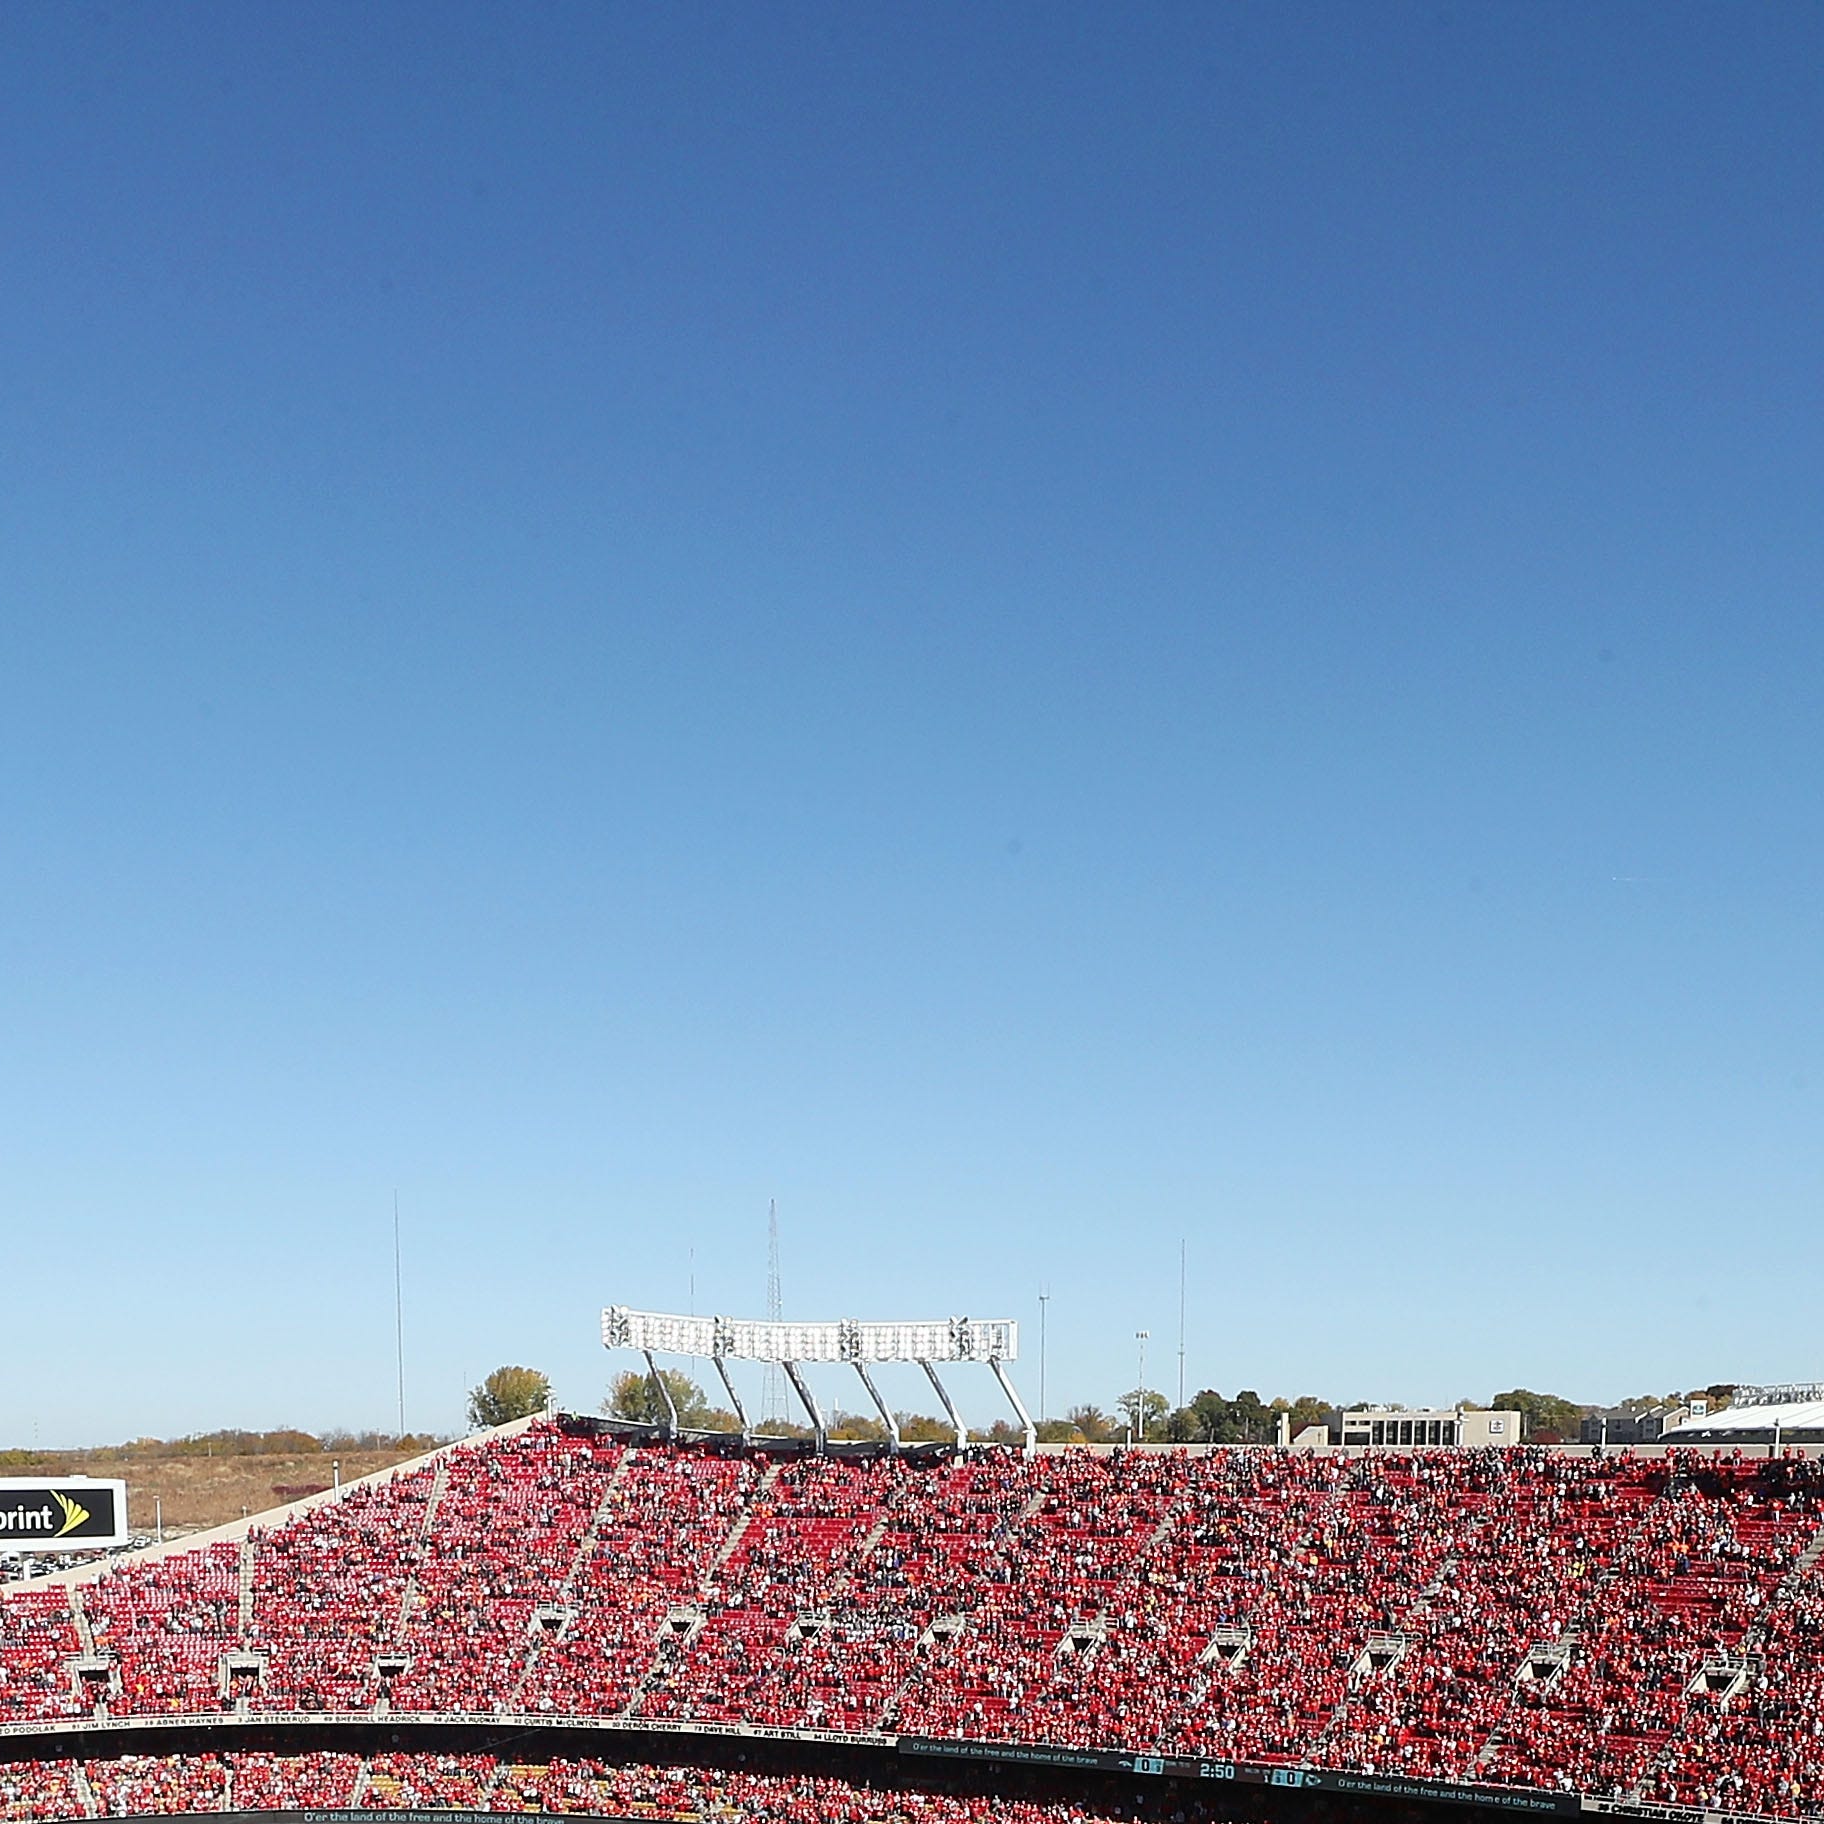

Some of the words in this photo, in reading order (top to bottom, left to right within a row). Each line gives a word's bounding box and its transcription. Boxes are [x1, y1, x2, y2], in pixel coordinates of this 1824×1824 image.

[13, 1725, 56, 1734] PODOLAK
[83, 1722, 99, 1730] JIM
[101, 1720, 131, 1729] LYNCH
[824, 1735, 849, 1743] LLOYD
[1200, 1763, 1235, 1780] 2:50
[1357, 1780, 1372, 1789] the
[1404, 1784, 1418, 1794] the
[1439, 1788, 1456, 1797] and
[1457, 1789, 1472, 1799] the
[1512, 1796, 1528, 1806] the
[330, 1812, 348, 1822] the
[350, 1812, 374, 1822] land
[376, 1812, 386, 1822] of
[389, 1812, 407, 1822] the
[409, 1812, 430, 1822] free
[433, 1813, 452, 1822] and
[454, 1813, 471, 1823] the
[473, 1813, 502, 1824] home
[504, 1814, 515, 1824] of
[517, 1815, 534, 1824] the
